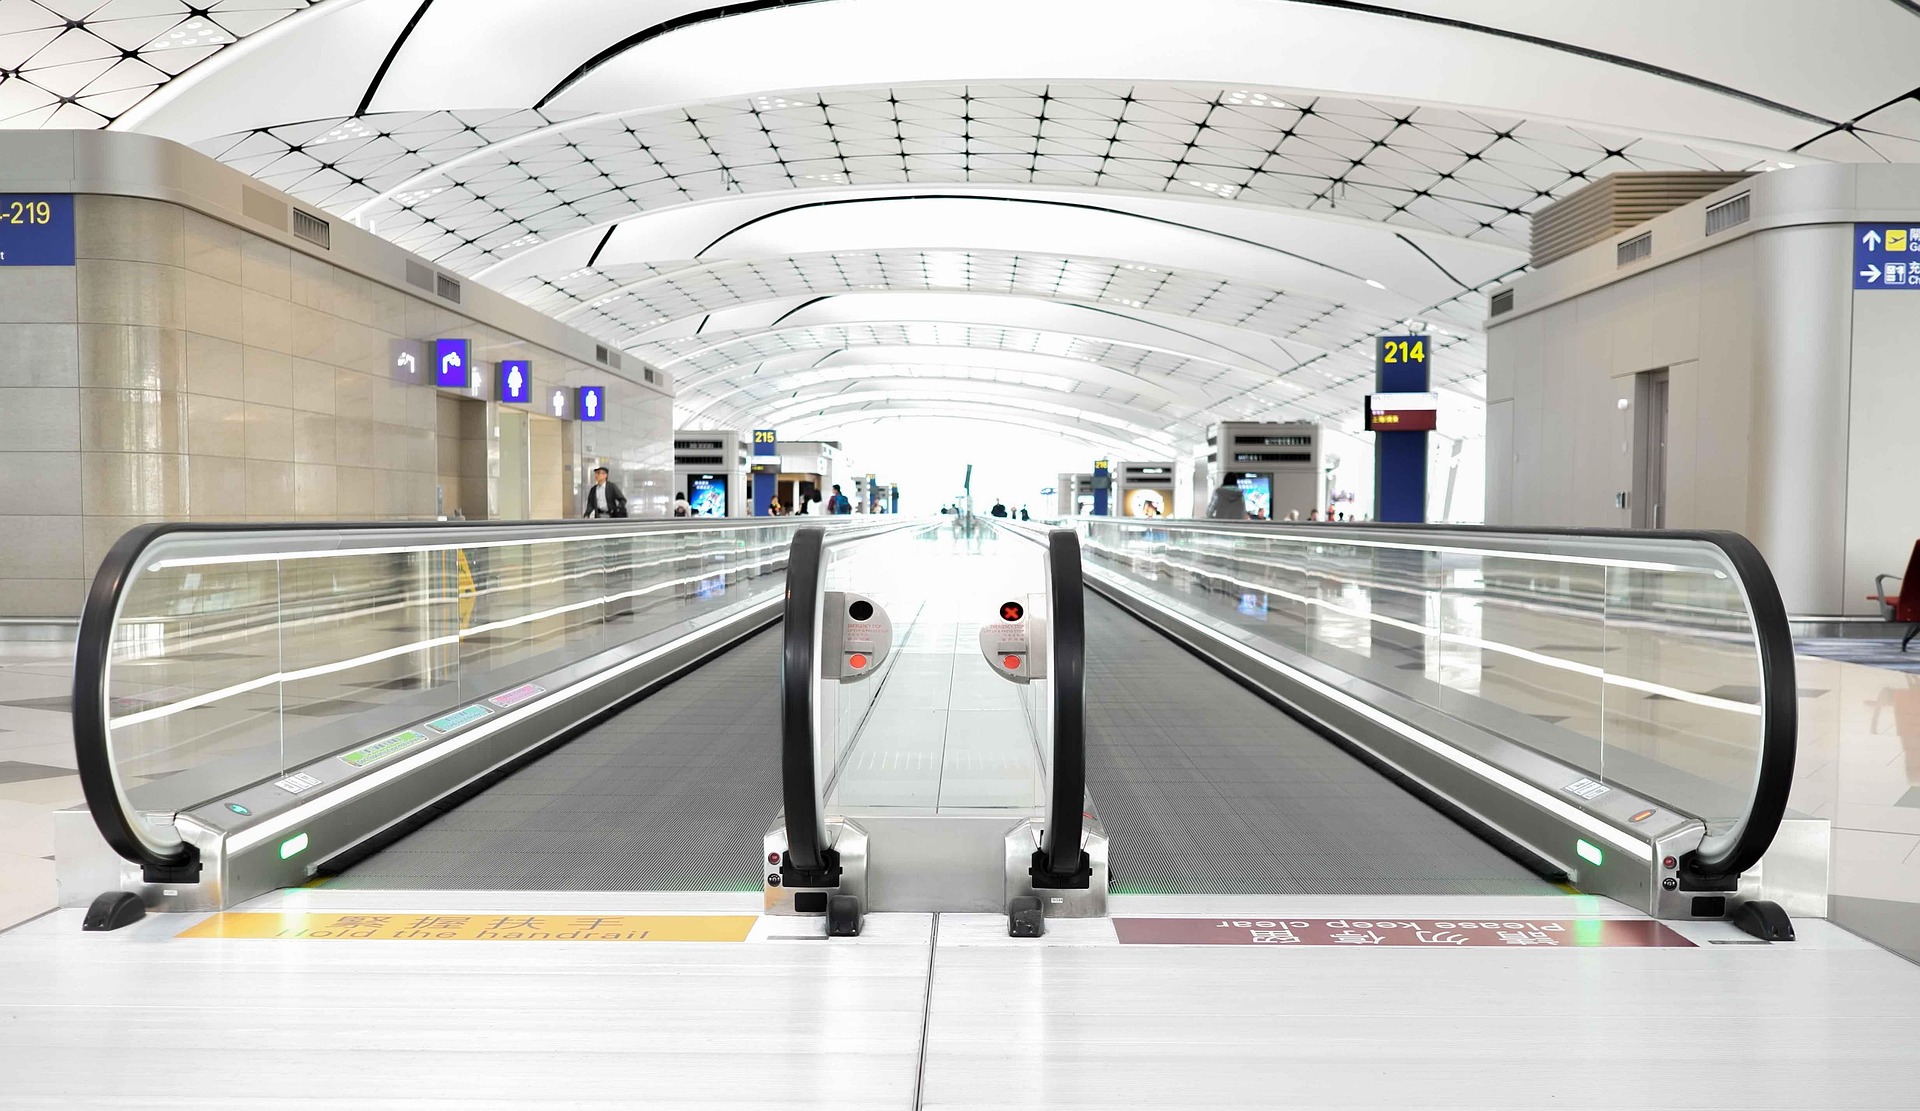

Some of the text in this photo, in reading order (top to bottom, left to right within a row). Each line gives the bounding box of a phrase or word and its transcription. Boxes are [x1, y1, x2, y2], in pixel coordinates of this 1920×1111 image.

[0, 201, 50, 224] -219
[1384, 341, 1425, 363] 214
[755, 431, 774, 443] 215
[326, 916, 625, 930] 緊握扶手
[1215, 920, 1566, 931] Please keep clear
[392, 930, 458, 938] the
[475, 930, 650, 939] handrail
[1249, 929, 1560, 945] 請勿停留
